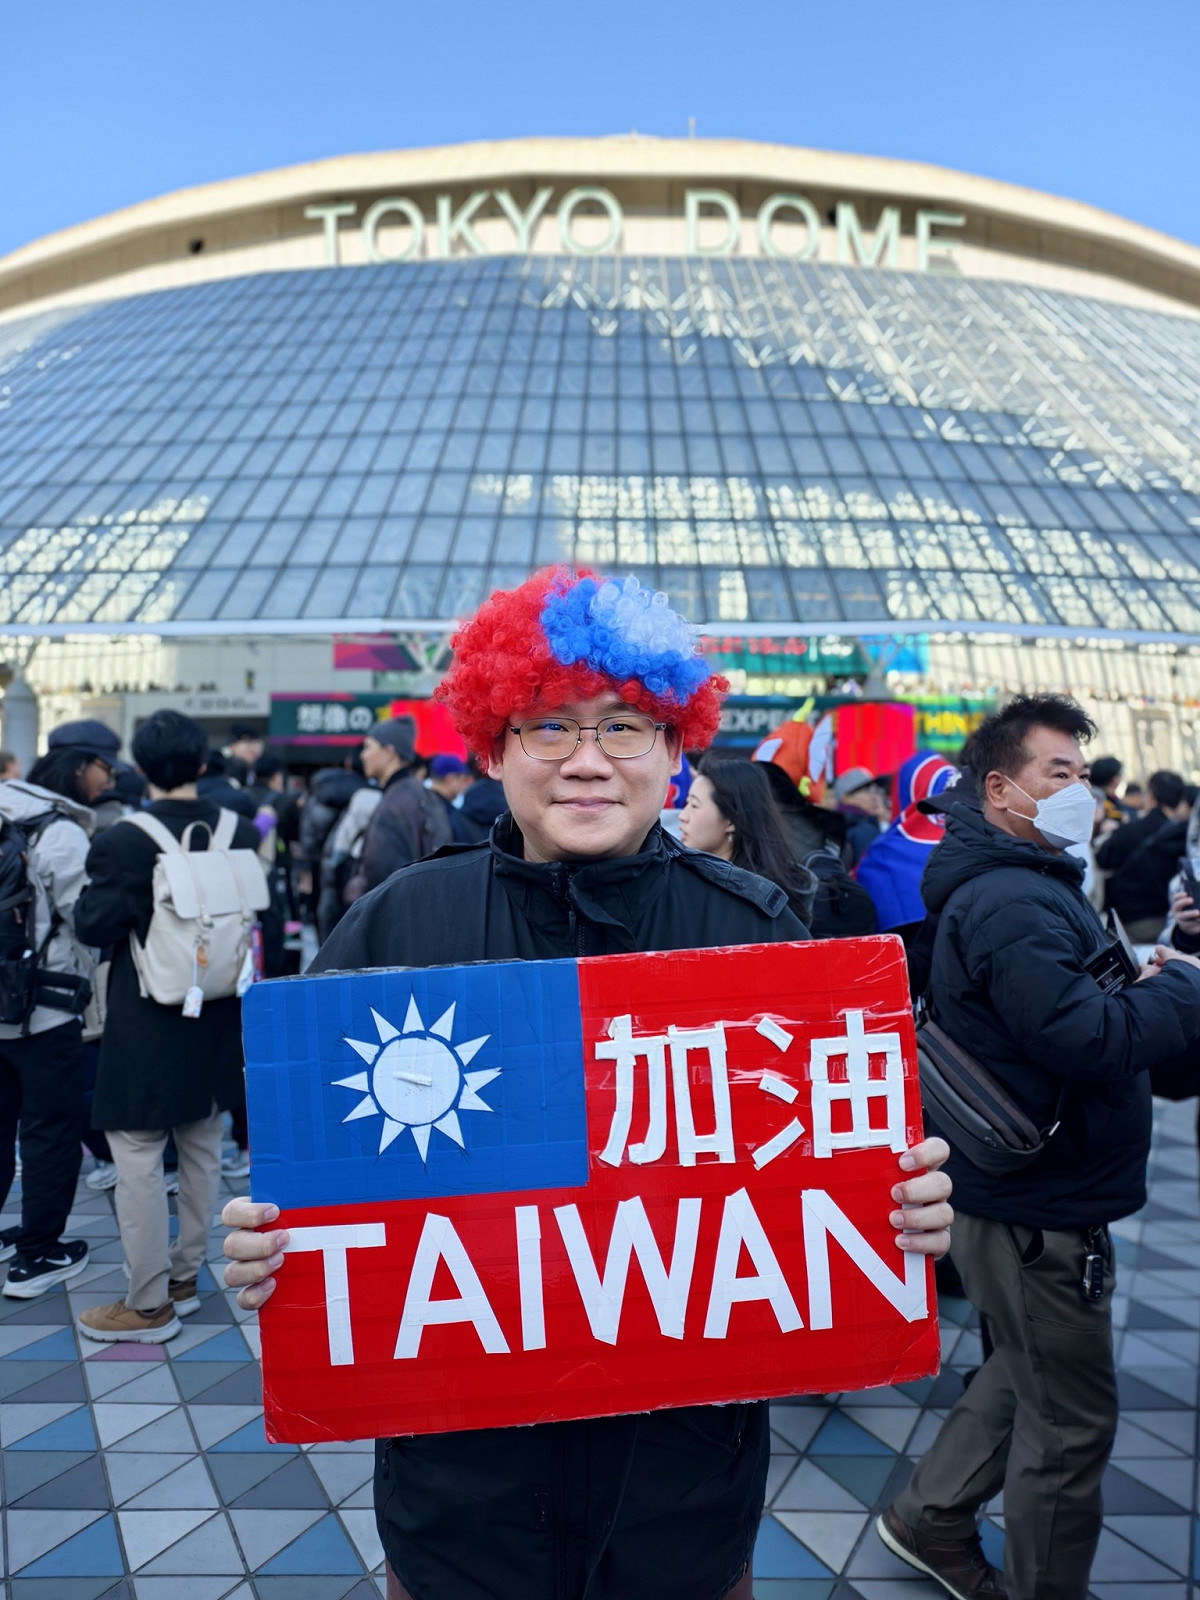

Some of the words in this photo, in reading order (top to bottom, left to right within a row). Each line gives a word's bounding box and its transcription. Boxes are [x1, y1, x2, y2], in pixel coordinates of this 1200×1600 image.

[304, 186, 624, 266] TOKYO
[684, 188, 966, 275] DOME
[718, 708, 821, 733] EXPET
[594, 1010, 908, 1170] 加油
[282, 1187, 928, 1366] TAIWAN
